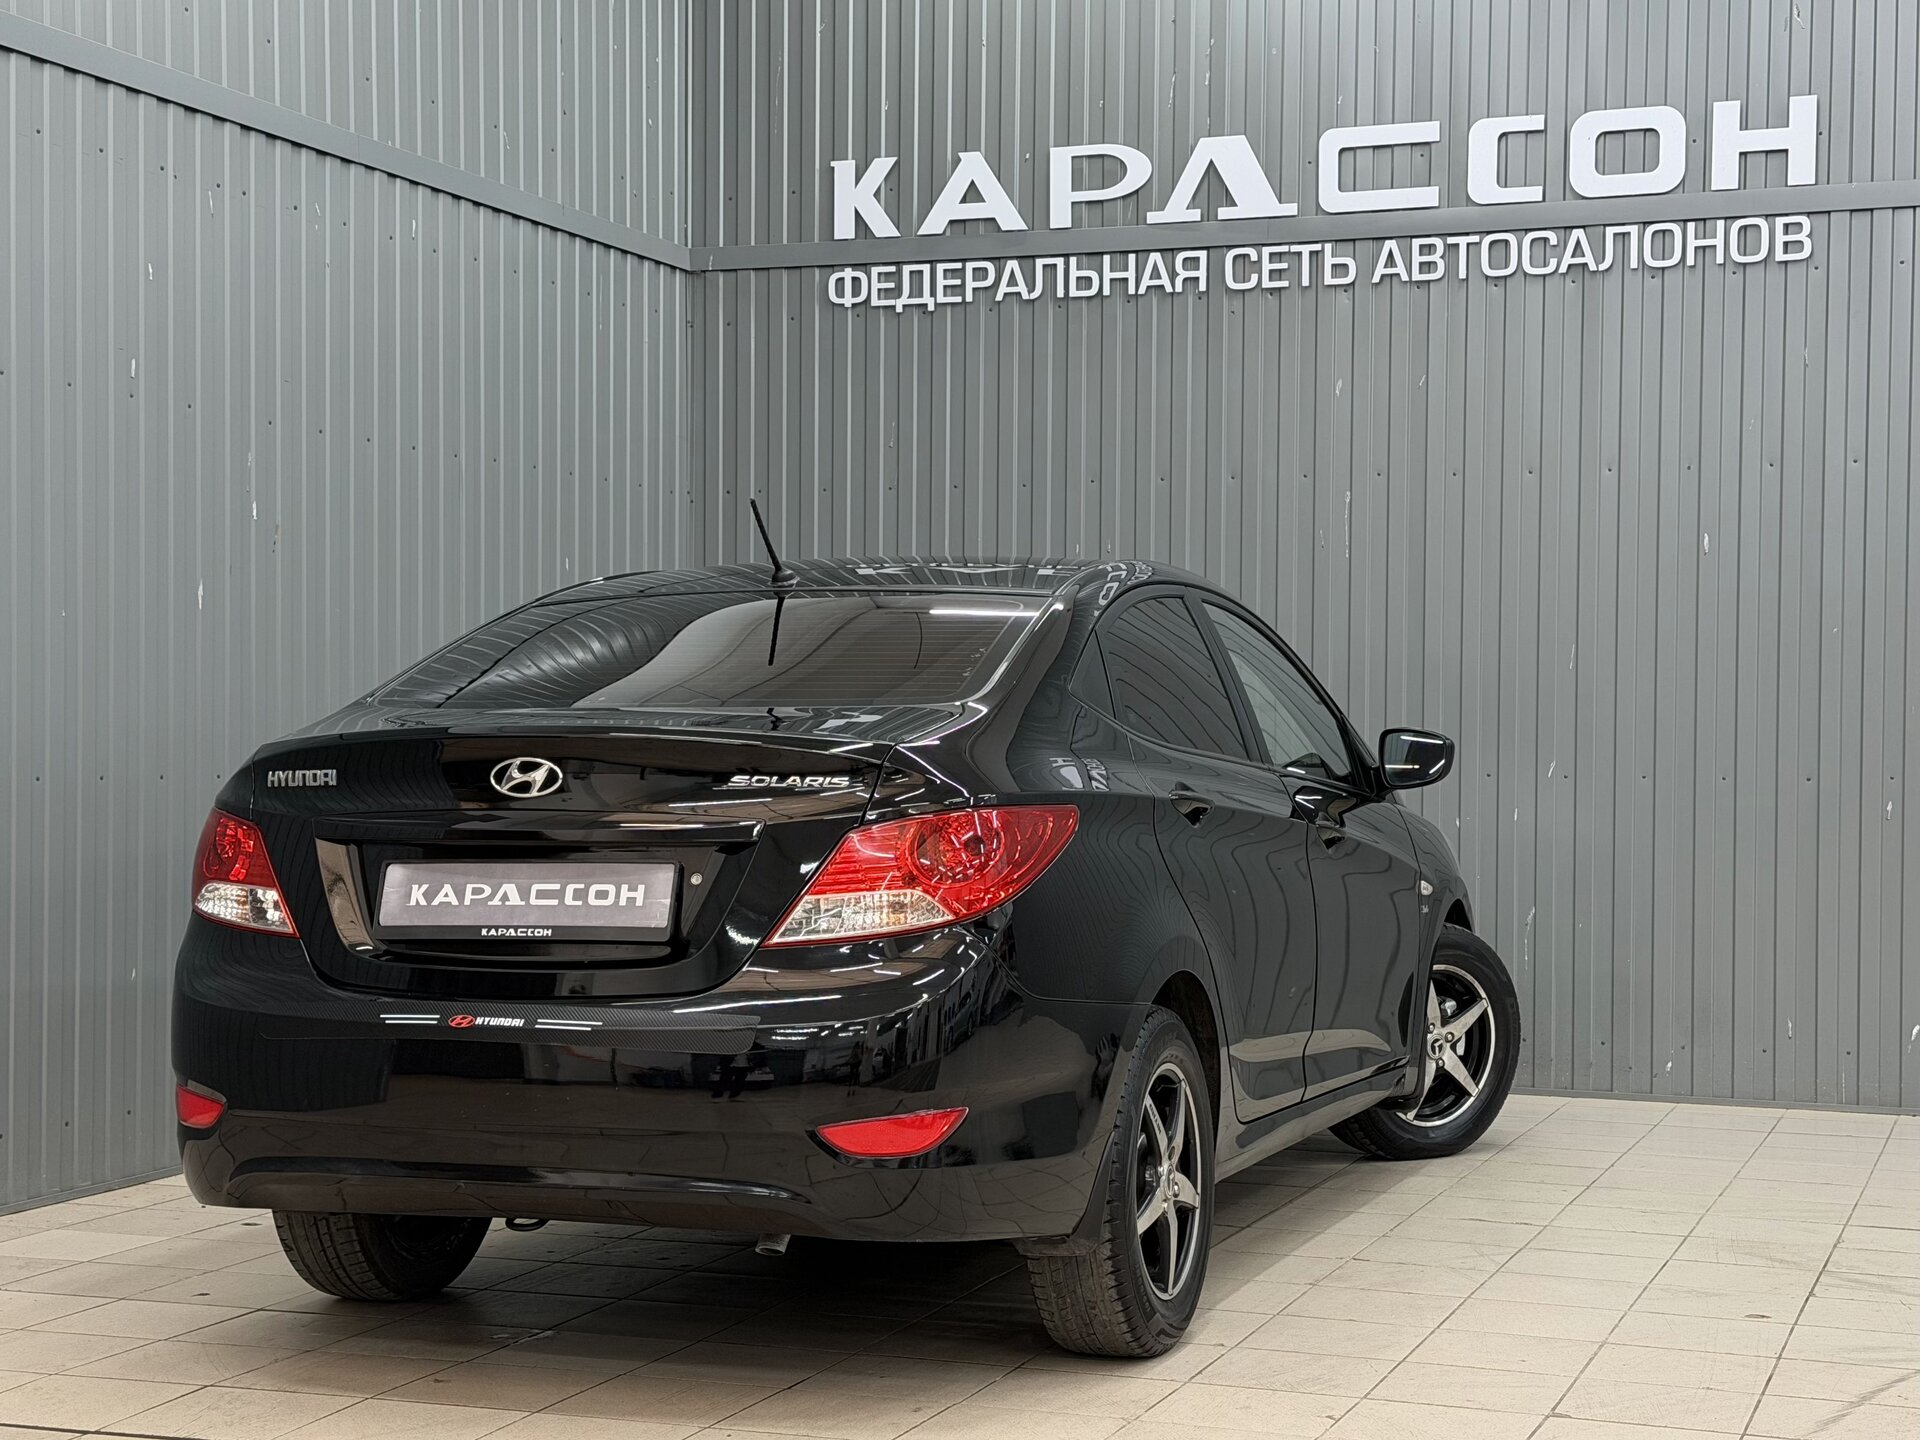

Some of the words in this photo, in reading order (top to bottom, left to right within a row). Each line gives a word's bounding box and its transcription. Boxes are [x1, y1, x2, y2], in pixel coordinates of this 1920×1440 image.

[828, 249, 1208, 313] ФЕДЕРАЛЬНАЯ
[1225, 243, 1357, 290] СЕТЬ
[1371, 215, 1813, 284] АВТОСАЛОНОВ
[267, 769, 337, 788] HYUNDAI
[727, 775, 850, 788] SOLARIS
[475, 1016, 525, 1027] HYUNDAI
